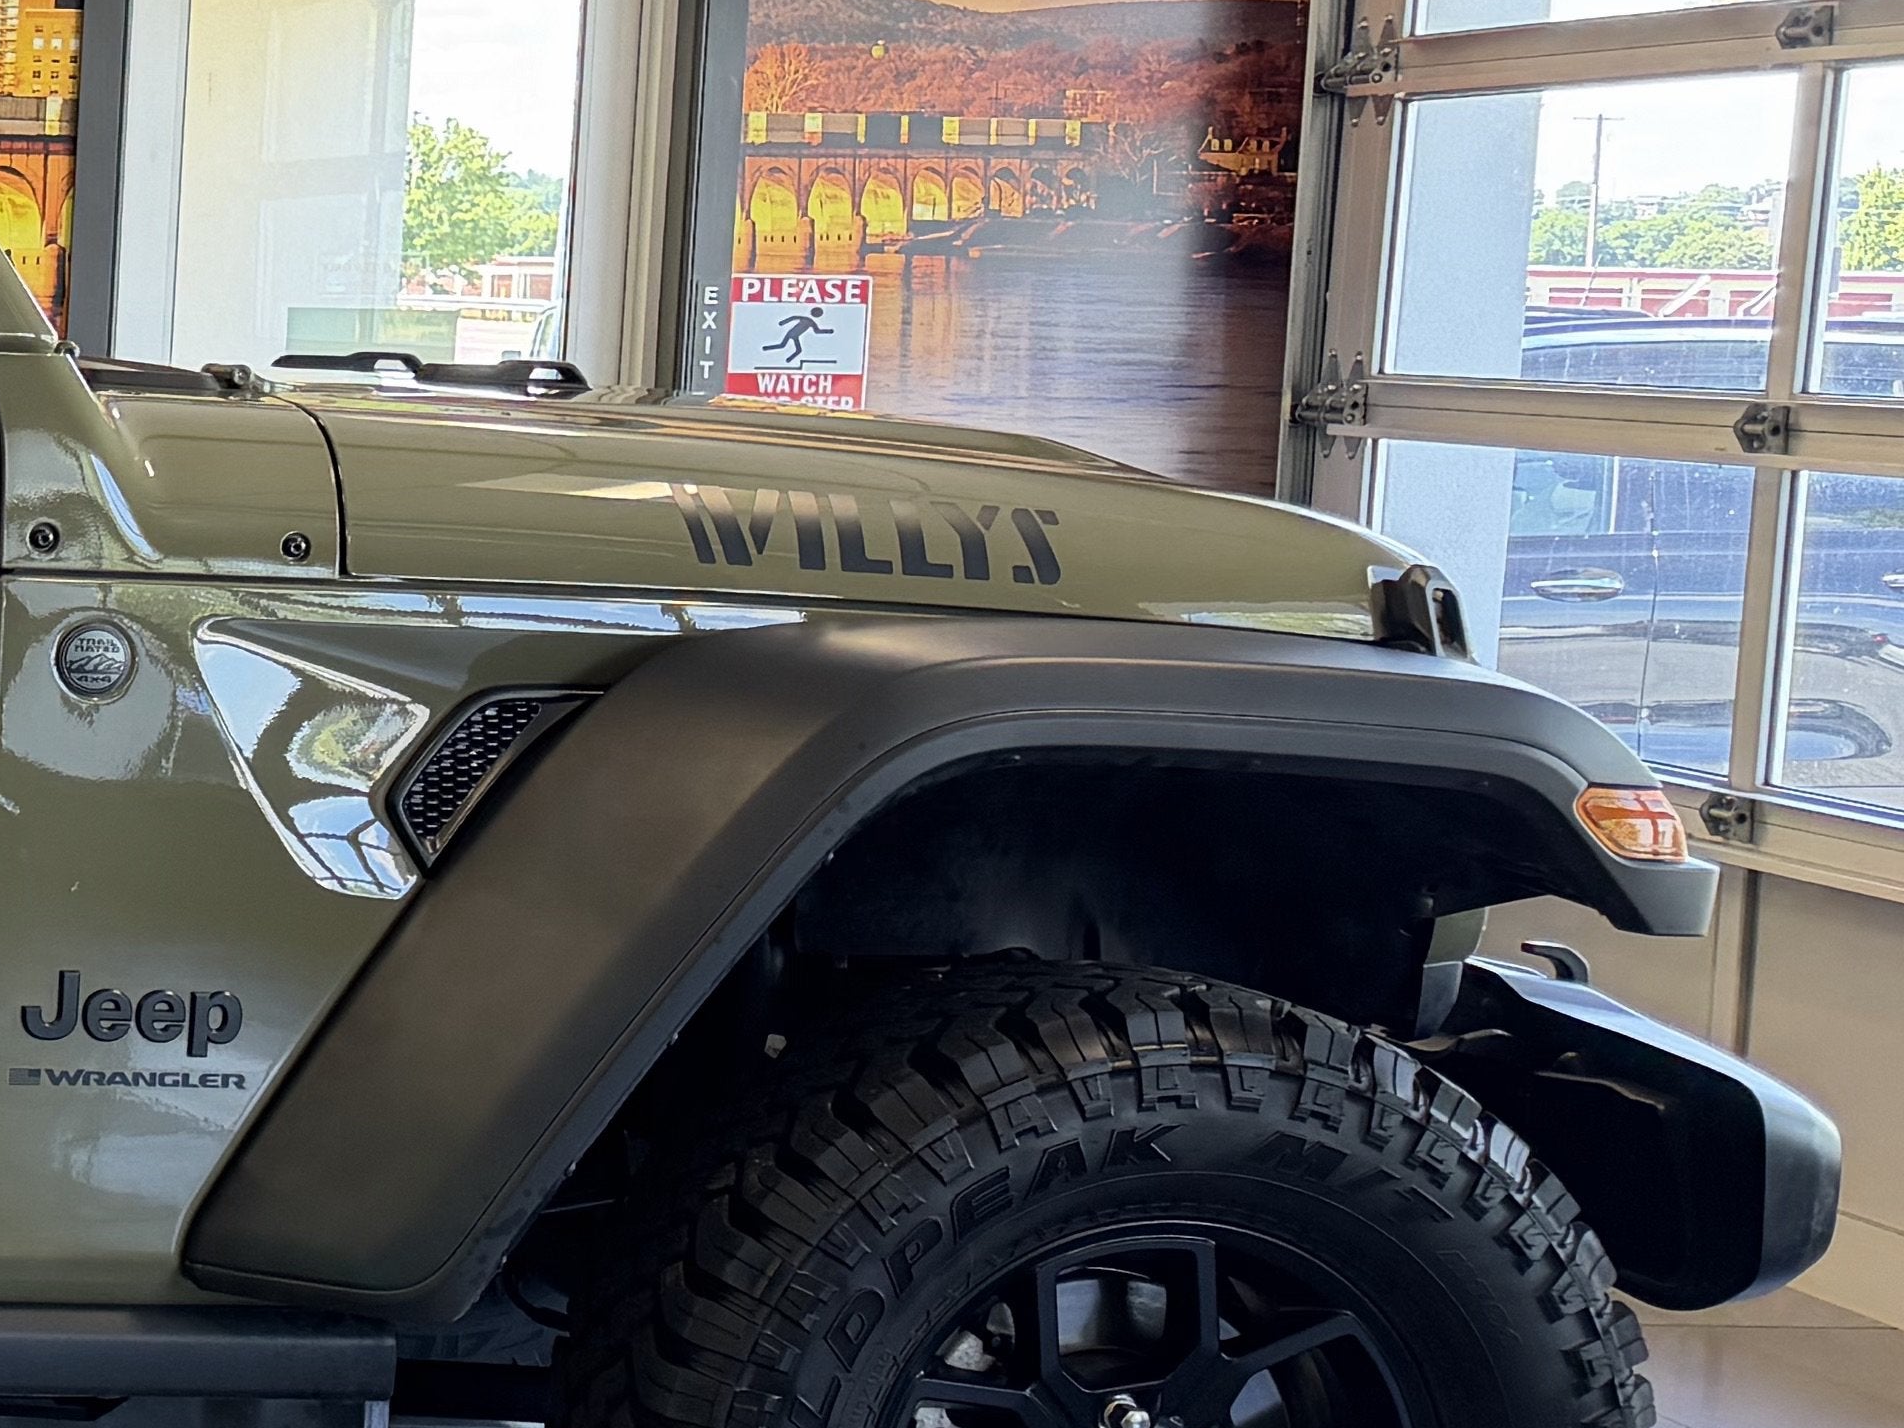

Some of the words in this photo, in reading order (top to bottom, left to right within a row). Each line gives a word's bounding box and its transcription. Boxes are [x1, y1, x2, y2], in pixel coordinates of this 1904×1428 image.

[741, 278, 862, 303] PLEASE
[699, 286, 719, 380] EXIT
[757, 373, 833, 394] WATCH
[669, 483, 1061, 585] WILLYS
[77, 638, 117, 646] TRAIL
[21, 970, 243, 1057] Jeep
[44, 1068, 246, 1090] WRANGLER
